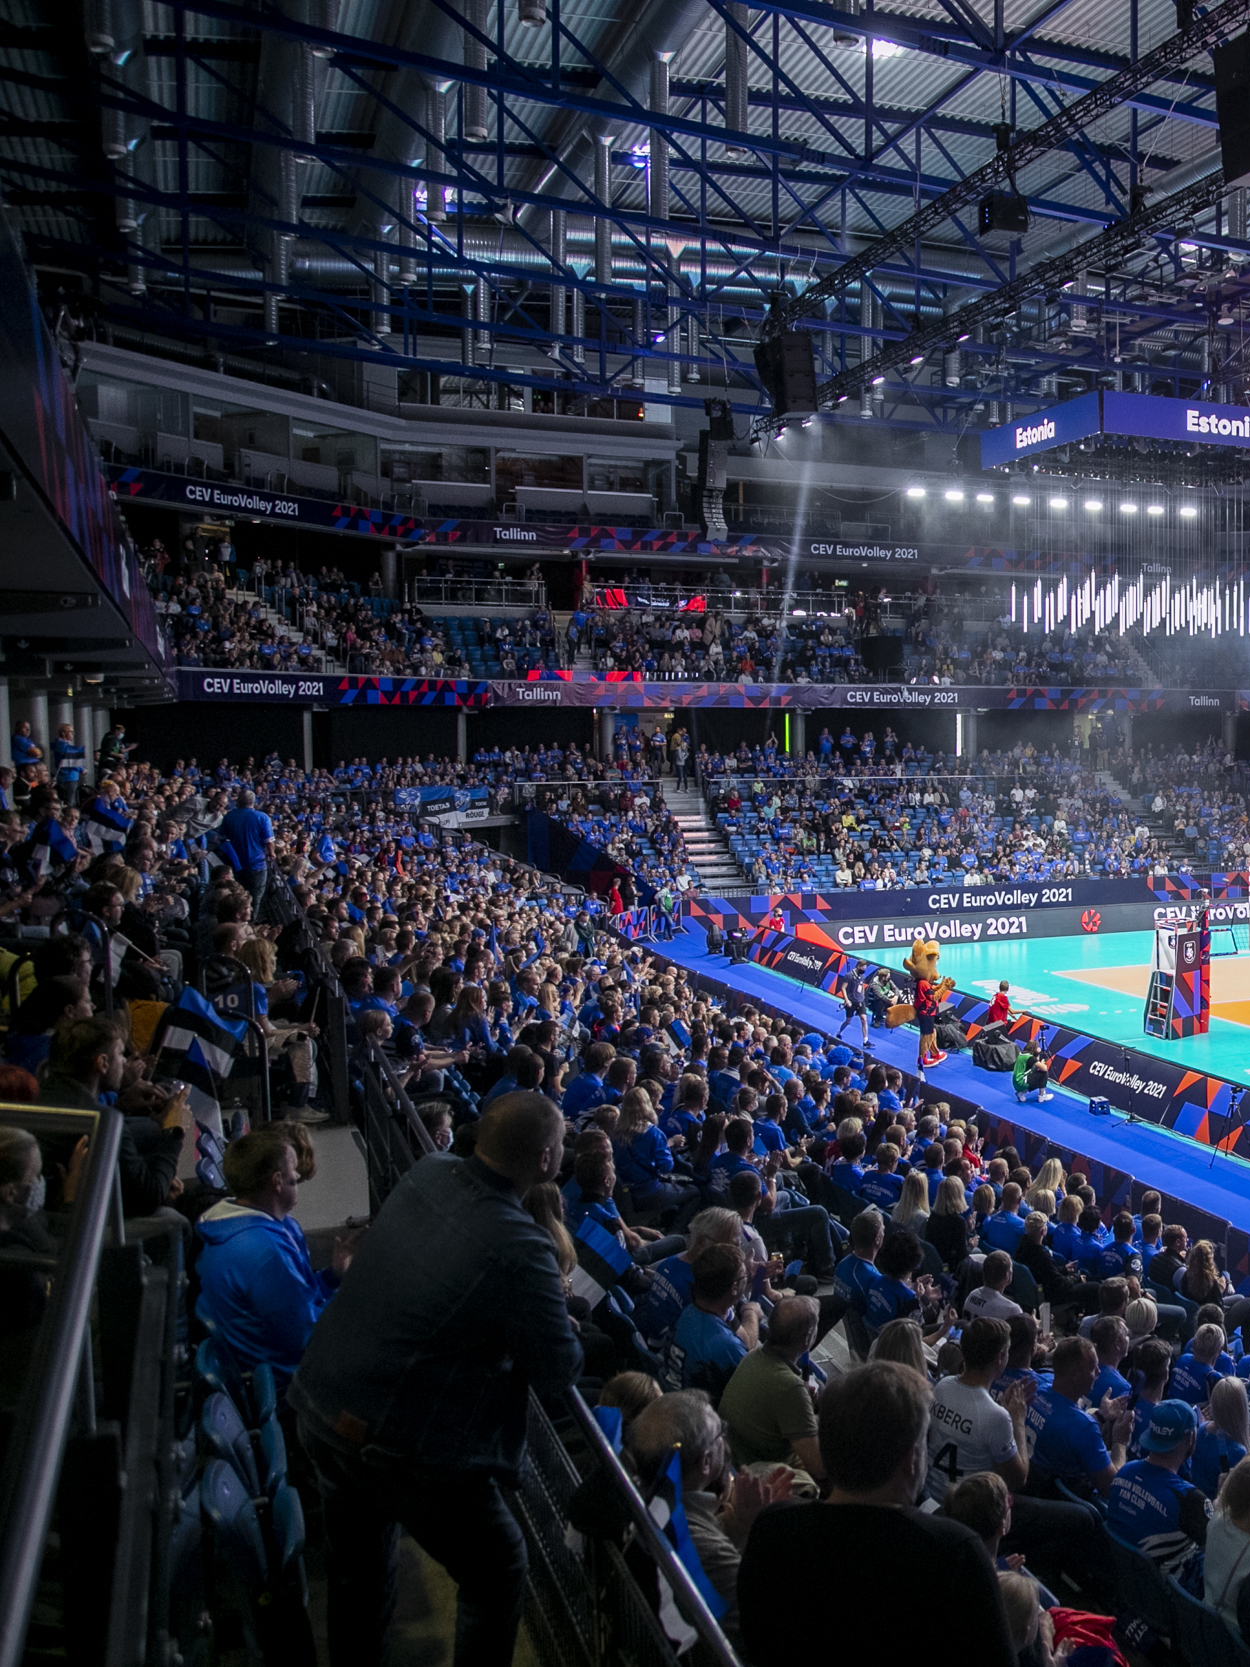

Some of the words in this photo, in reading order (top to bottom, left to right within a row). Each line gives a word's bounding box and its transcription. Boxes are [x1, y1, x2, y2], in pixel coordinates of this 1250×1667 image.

[1016, 418, 1055, 449] Estonia
[185, 485, 211, 501] CEV
[213, 489, 272, 514] EuroVolley
[274, 500, 299, 516] 2021
[493, 527, 537, 541] Tallinn
[810, 543, 834, 555] CEV
[836, 545, 892, 560] EuroVolley
[894, 548, 918, 559] 2021
[1141, 563, 1172, 573] Tallinn
[203, 677, 231, 693] CEV
[232, 678, 296, 698] EuroVolley
[298, 681, 323, 695] 2021
[516, 687, 561, 700] Tallinn
[846, 691, 871, 703] CEV
[934, 692, 958, 703] 2021
[1189, 695, 1220, 706] Tallinn
[928, 894, 961, 909] CEV
[963, 890, 1038, 907] EuroVolley
[1042, 888, 1072, 903] 2021
[1153, 906, 1186, 922] CEV
[839, 926, 880, 944] CEV
[884, 921, 982, 943] EuroVolley
[986, 916, 1027, 936] 2021
[214, 993, 239, 1009] 10
[1090, 1061, 1107, 1076] CEV
[1104, 1066, 1145, 1093] EuroVolley
[1145, 1080, 1167, 1099] 2021
[932, 1442, 964, 1482] 4
[1119, 1488, 1131, 1501] FAN
